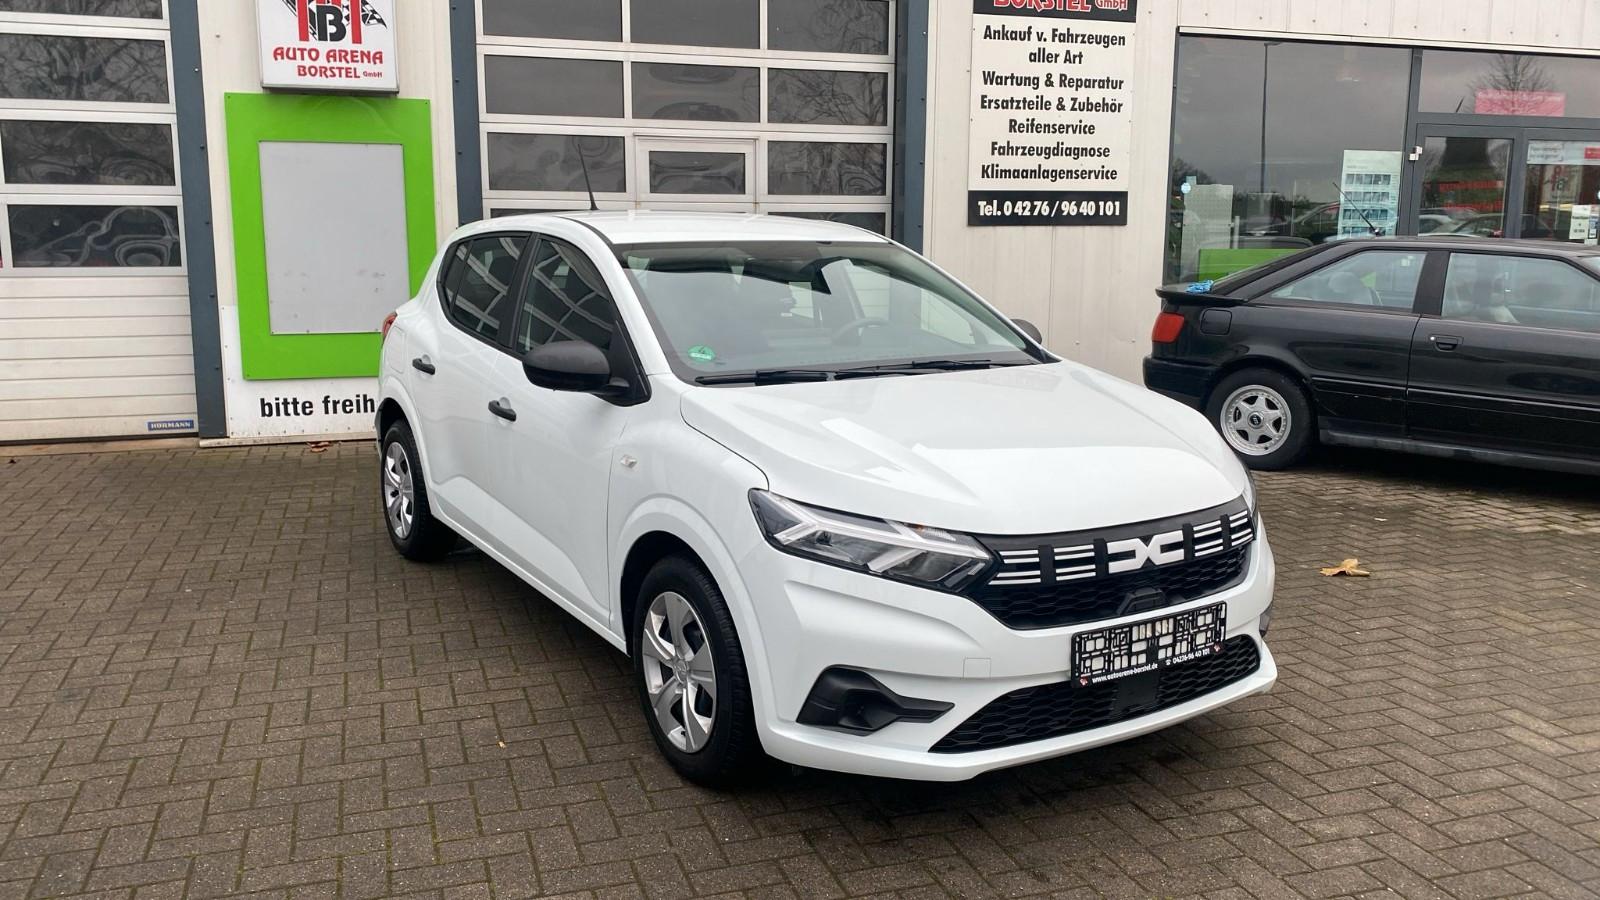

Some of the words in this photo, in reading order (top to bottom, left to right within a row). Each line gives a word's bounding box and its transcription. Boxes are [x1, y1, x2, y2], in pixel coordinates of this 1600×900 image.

[983, 24, 1033, 42] Ankauf
[1036, 31, 1047, 42] v.
[1051, 28, 1126, 48] Fahrzeugen
[273, 47, 320, 61] AUTO
[325, 49, 384, 65] ARENA
[1028, 47, 1060, 64] aller
[1063, 50, 1083, 65] Art
[297, 65, 361, 79] BORSTEL
[362, 71, 382, 79] GmbH
[982, 71, 1040, 90] Wartung
[1044, 73, 1054, 88] &
[1059, 74, 1124, 91] Reparatur
[980, 95, 1052, 111] Ersatzteile
[1056, 97, 1066, 111] &
[1070, 97, 1123, 113] Zubehör
[1008, 118, 1095, 135] Reifenservice
[991, 141, 1110, 160] Fahrzeugdiagnose
[981, 163, 1118, 183] Klimaanlagenservice
[978, 200, 1002, 216] Tel.
[1098, 201, 1120, 216] 101
[260, 398, 313, 418] bitte
[322, 394, 375, 415] freih
